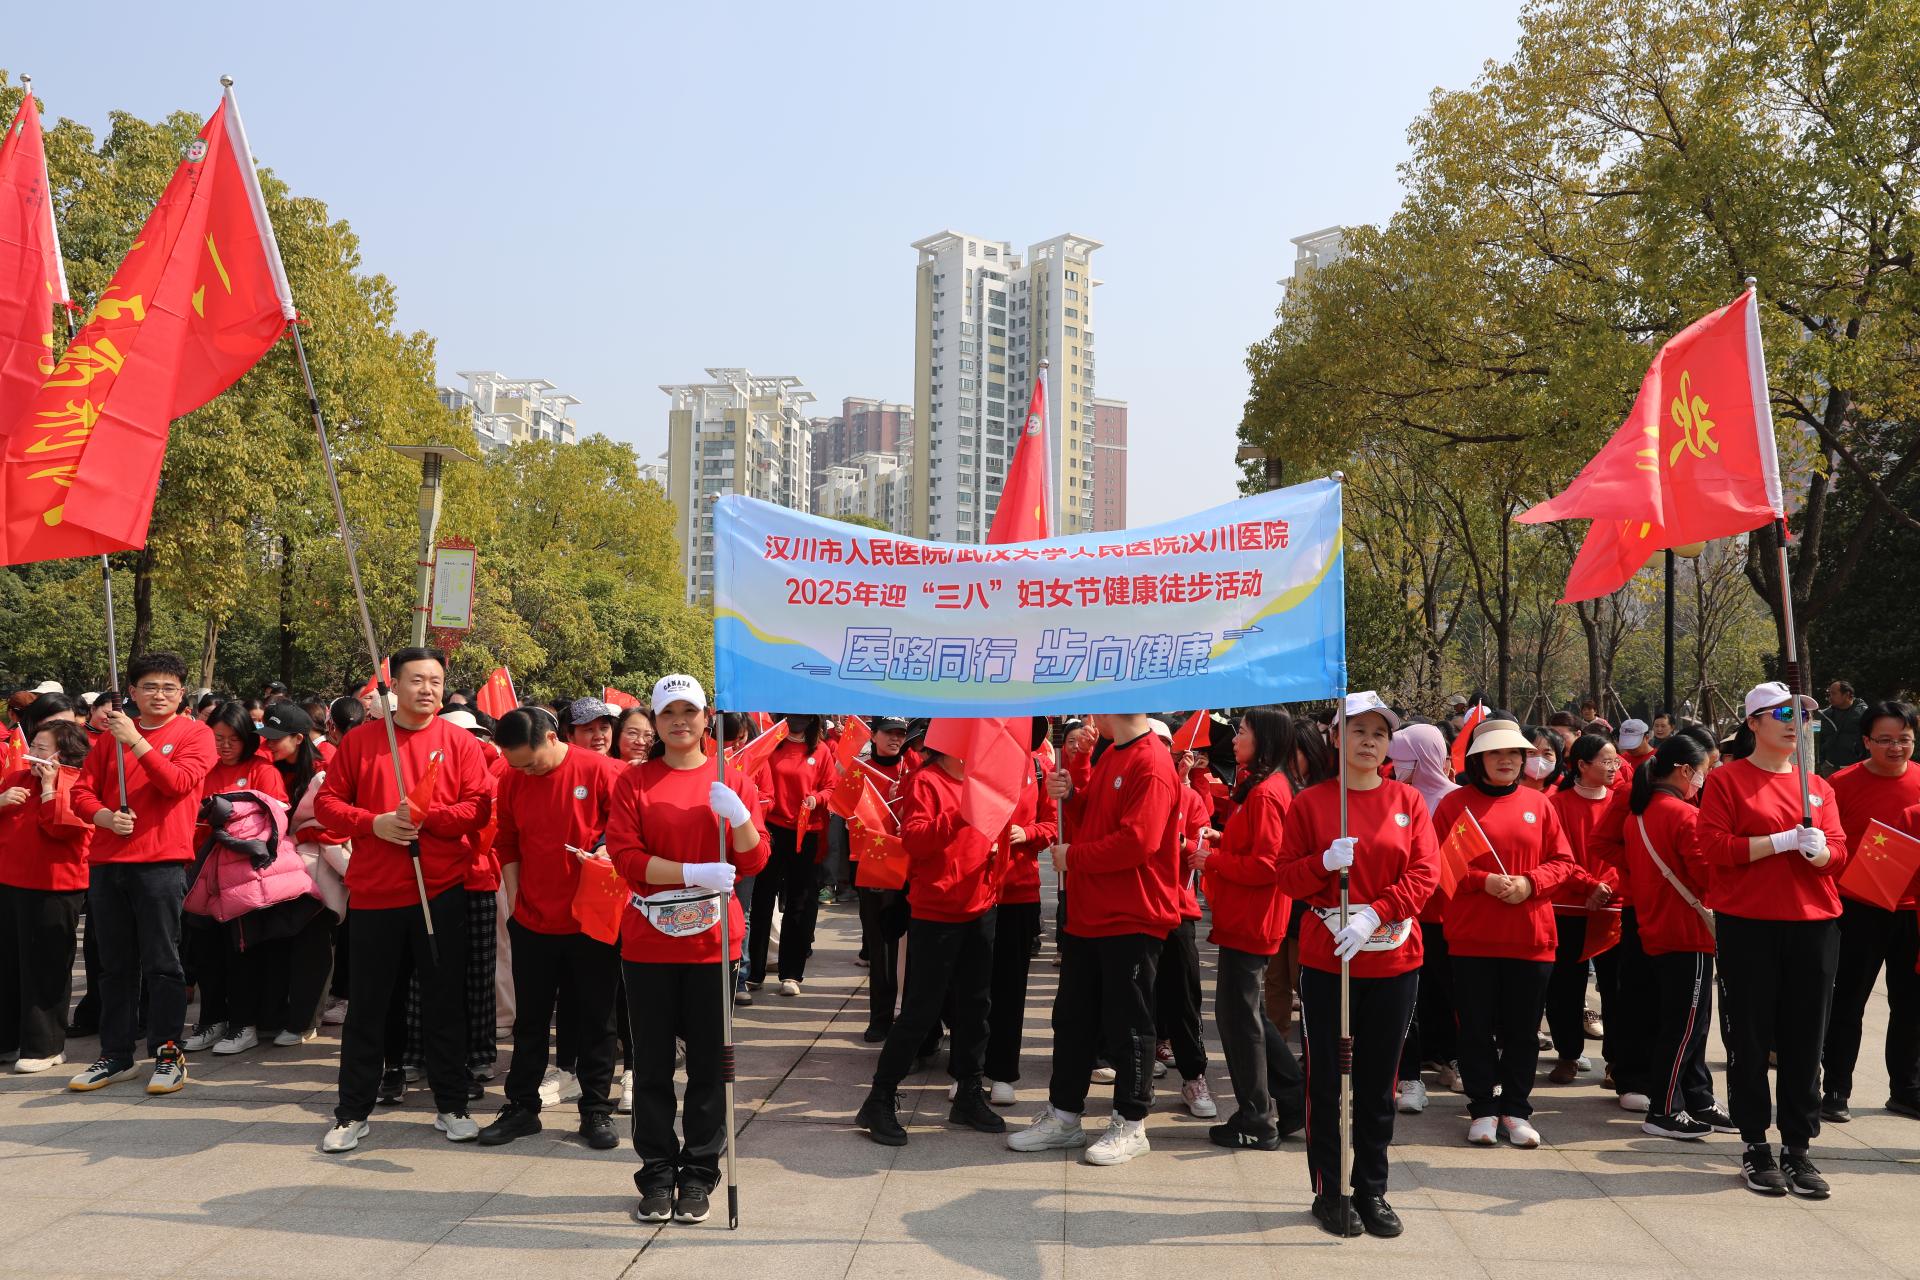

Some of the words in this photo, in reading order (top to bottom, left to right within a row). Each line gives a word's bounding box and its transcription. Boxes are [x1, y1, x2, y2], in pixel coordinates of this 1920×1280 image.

[838, 627, 1017, 682] 医路同行
[1033, 628, 1212, 684] 步向健康
[663, 680, 690, 690] CANADA
